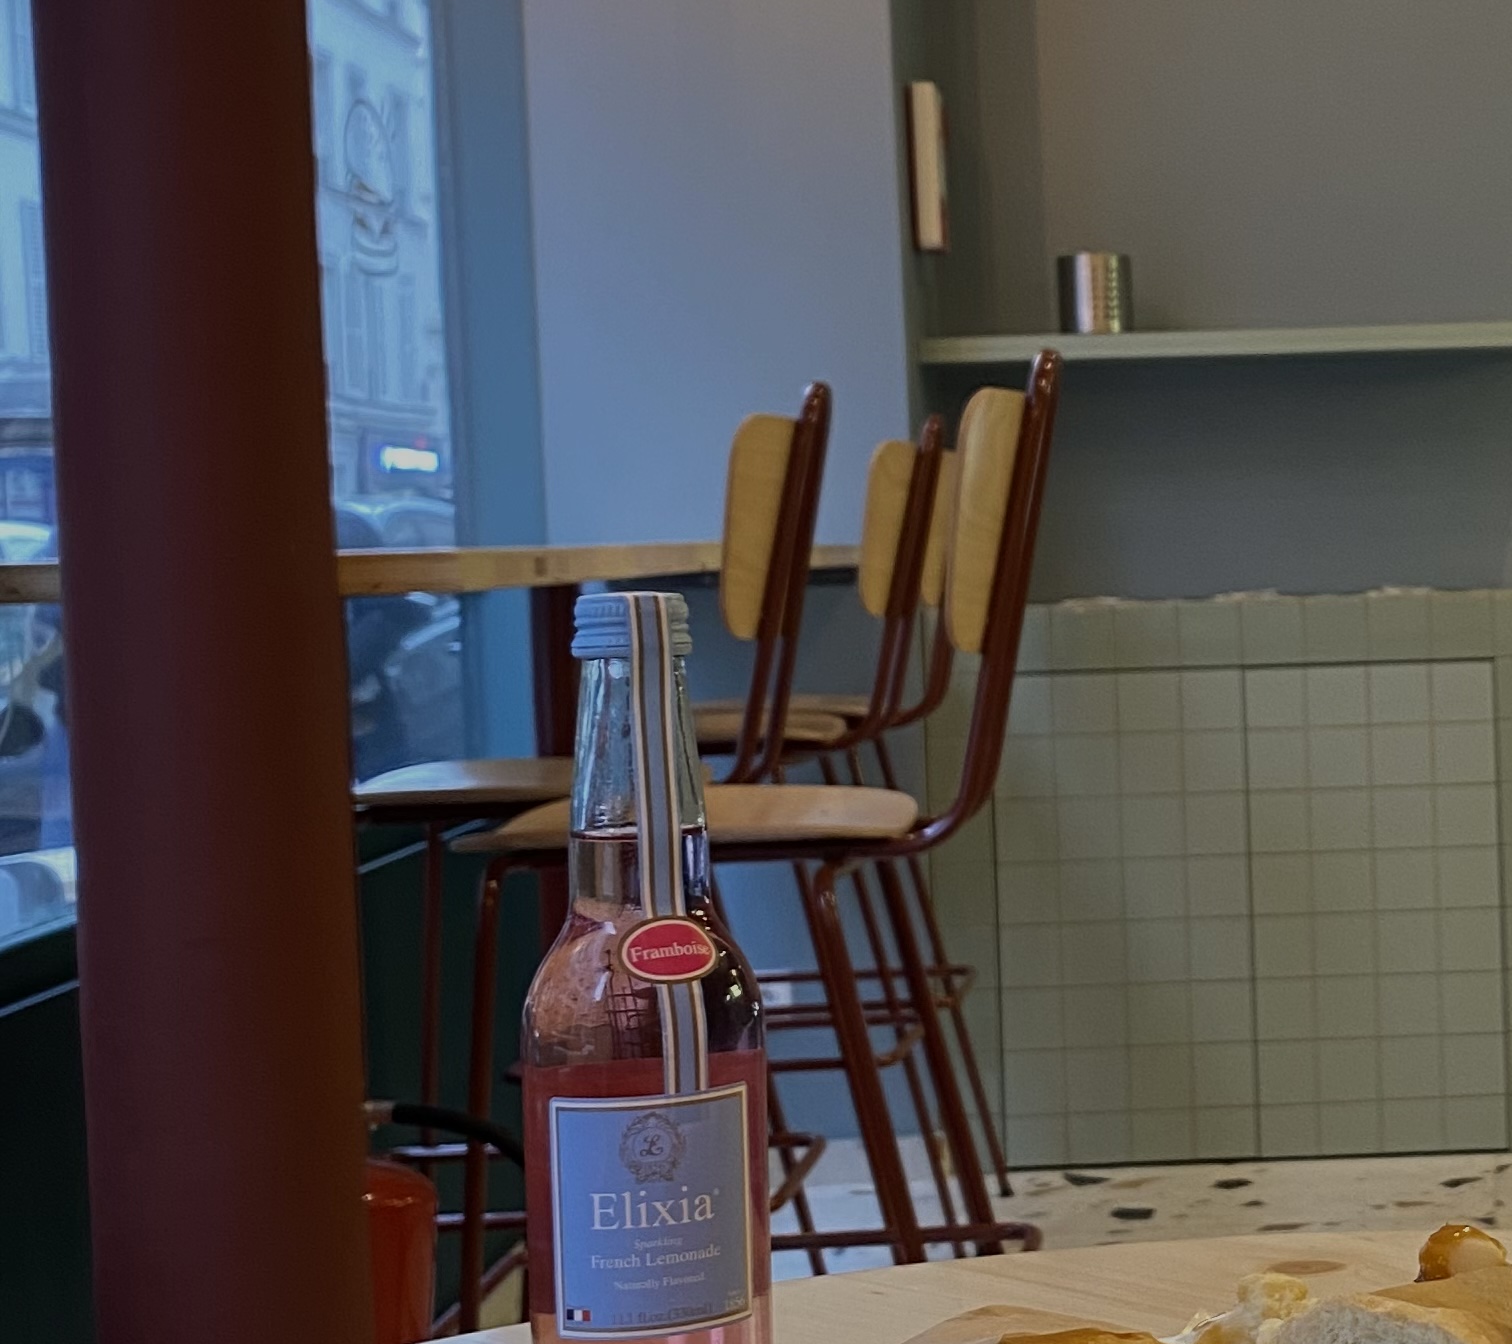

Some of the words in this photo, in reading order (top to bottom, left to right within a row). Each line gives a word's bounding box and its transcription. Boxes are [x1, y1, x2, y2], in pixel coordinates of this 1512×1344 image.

[629, 941, 710, 963] Framboise
[589, 1185, 715, 1231] Elixia
[591, 1253, 641, 1269] French
[646, 1244, 721, 1266] Lemonade
